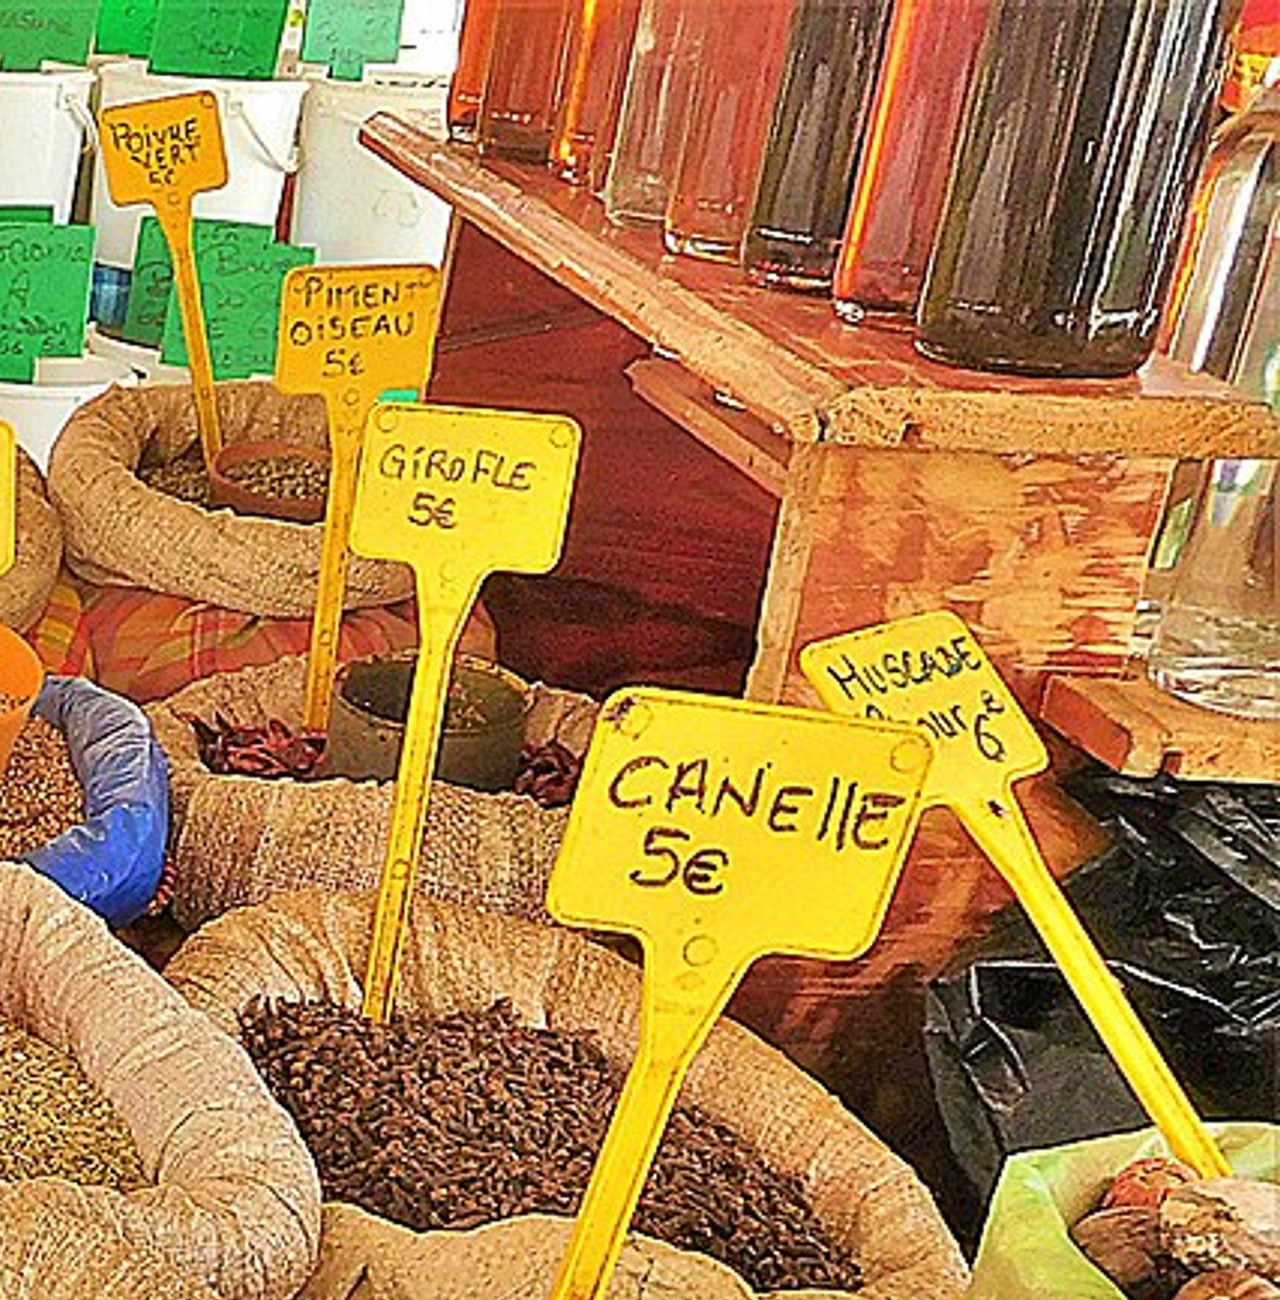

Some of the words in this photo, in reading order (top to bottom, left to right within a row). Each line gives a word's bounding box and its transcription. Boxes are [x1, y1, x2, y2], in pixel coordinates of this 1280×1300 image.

[322, 349, 365, 379] 5€
[406, 491, 459, 530] 5€
[628, 826, 731, 896] 5€
